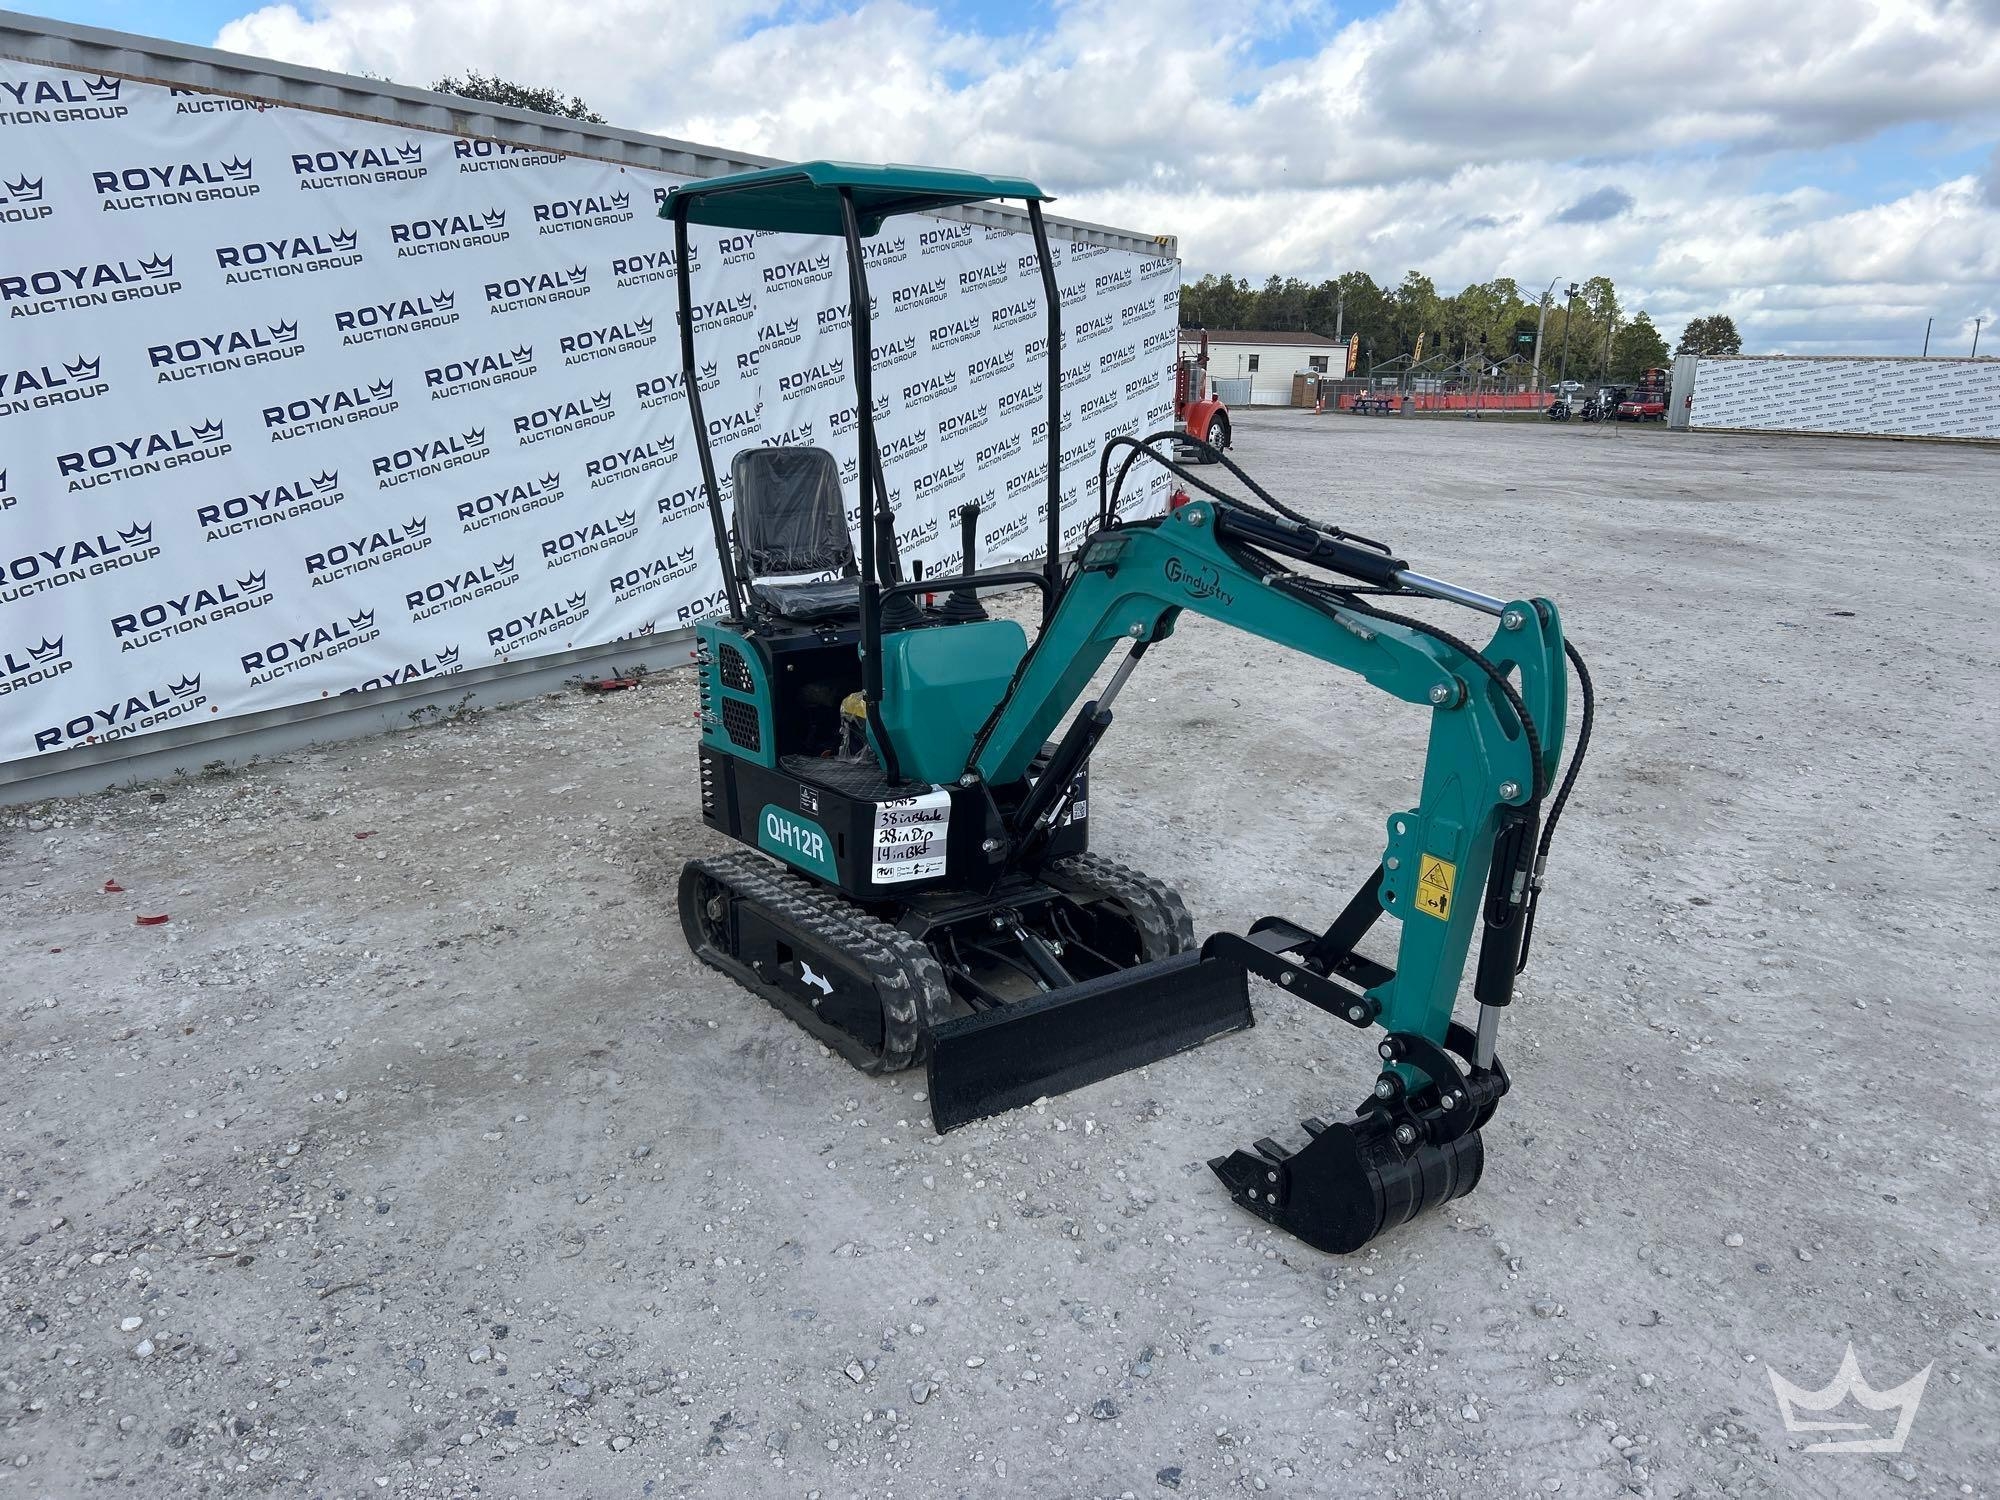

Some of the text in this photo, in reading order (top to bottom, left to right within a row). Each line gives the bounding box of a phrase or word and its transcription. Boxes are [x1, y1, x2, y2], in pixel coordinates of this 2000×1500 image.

[54, 105, 128, 123] GROUP
[291, 147, 399, 174] ROYAL
[460, 158, 519, 173] AUCTION
[92, 162, 224, 193] ROYAL
[300, 168, 427, 190] AUCTION GROUP
[103, 184, 259, 211] AUCTION GROUP
[534, 196, 612, 221] ROYAL
[390, 214, 484, 243] ROYAL
[539, 212, 633, 235] AUCTION GROUP
[919, 226, 961, 245] ROYAL
[216, 235, 332, 268] ROYAL
[397, 231, 509, 258] AUCTION GROUP
[921, 238, 972, 255] AUCTION GROUP
[0, 261, 143, 300] ROYAL
[225, 254, 362, 284] AUCTION GROUP
[617, 269, 665, 288] AUCTION
[762, 259, 817, 282] ROYAL
[766, 271, 831, 293] AUCTION GROUP
[959, 265, 997, 285] ROYAL
[1095, 270, 1124, 288] ROYAL
[10, 281, 181, 318] AUCTION GROUP
[484, 271, 568, 301] ROYAL
[490, 286, 590, 314] AUCTION GROUP
[892, 281, 935, 303] ROYAL
[335, 297, 433, 331] ROYAL
[894, 292, 947, 313] AUCTION GROUP
[991, 301, 1027, 322] ROYAL
[1121, 301, 1148, 319] ROYAL
[343, 313, 459, 346] AUCTION GROUP
[723, 311, 754, 326] GROUP
[929, 319, 970, 342] ROYAL
[1075, 317, 1105, 336] ROYAL
[147, 328, 271, 367] ROYAL
[559, 323, 636, 353] ROYAL
[564, 336, 656, 366] AUCTION GROUP
[931, 329, 980, 351] AUCTION GROUP
[1143, 330, 1168, 348] ROYAL
[1350, 336, 1359, 369] OPEN
[158, 345, 304, 383] AUCTION GROUP
[424, 352, 513, 387] ROYAL
[968, 354, 1004, 376] ROYAL
[1099, 347, 1128, 366] ROYAL
[431, 365, 536, 400] AUCTION GROUP
[779, 364, 830, 391] ROYAL
[782, 374, 843, 402] AUCTION GROUP
[902, 375, 945, 400] ROYAL
[1125, 374, 1152, 393] ROYAL
[33, 383, 109, 408] GROUP
[263, 387, 370, 427] ROYAL
[640, 390, 686, 410] AUCTION
[904, 384, 956, 409] AUCTION GROUP
[998, 386, 1033, 409] ROYAL
[1080, 393, 1110, 414] ROYAL
[272, 401, 399, 442] AUCTION GROUP
[513, 399, 593, 433] ROYAL
[519, 410, 614, 446] AUCTION GROUP
[939, 409, 978, 433] ROYAL
[940, 417, 988, 442] AUCTION GROUP
[56, 430, 194, 476] ROYAL
[372, 436, 464, 476] ROYAL
[586, 443, 658, 477] ROYAL
[976, 438, 1011, 463] ROYAL
[67, 444, 230, 492] AUCTION GROUP
[379, 447, 489, 489] AUCTION GROUP
[590, 453, 678, 489] AUCTION GROUP
[913, 465, 954, 492] ROYAL
[1005, 468, 1040, 492] ROYAL
[915, 472, 965, 500] AUCTION GROUP
[197, 481, 313, 527] ROYAL
[457, 481, 541, 521] ROYAL
[463, 491, 563, 533] AUCTION GROUP
[661, 501, 705, 525] AUCTION
[206, 492, 344, 542] AUCTION GROUP
[541, 519, 618, 557] ROYAL
[984, 520, 1019, 546] ROYAL
[305, 528, 404, 574] ROYAL
[312, 537, 431, 587] AUCTION GROUP
[546, 527, 638, 569] AUCTION GROUP
[0, 546, 159, 604] UCTION GROUP
[405, 565, 495, 610] ROYAL
[609, 555, 678, 593] ROYAL
[614, 562, 697, 604] AUCTION GROUP
[111, 584, 239, 637] ROYAL
[412, 573, 518, 623] AUCTION GROUP
[121, 593, 272, 652] AUCTION GROUP
[487, 602, 568, 645] ROYAL
[493, 609, 589, 657] AUCTION GROUP
[241, 622, 350, 673] ROYAL
[250, 629, 379, 687] AUCTION GROUP
[0, 660, 73, 696] GROUP
[35, 690, 171, 751] ROYAL
[140, 695, 206, 727] GROUP
[881, 812, 897, 827] 38
[767, 813, 824, 862] QH12R
[880, 828, 897, 843] 28
[877, 847, 890, 861] 14
